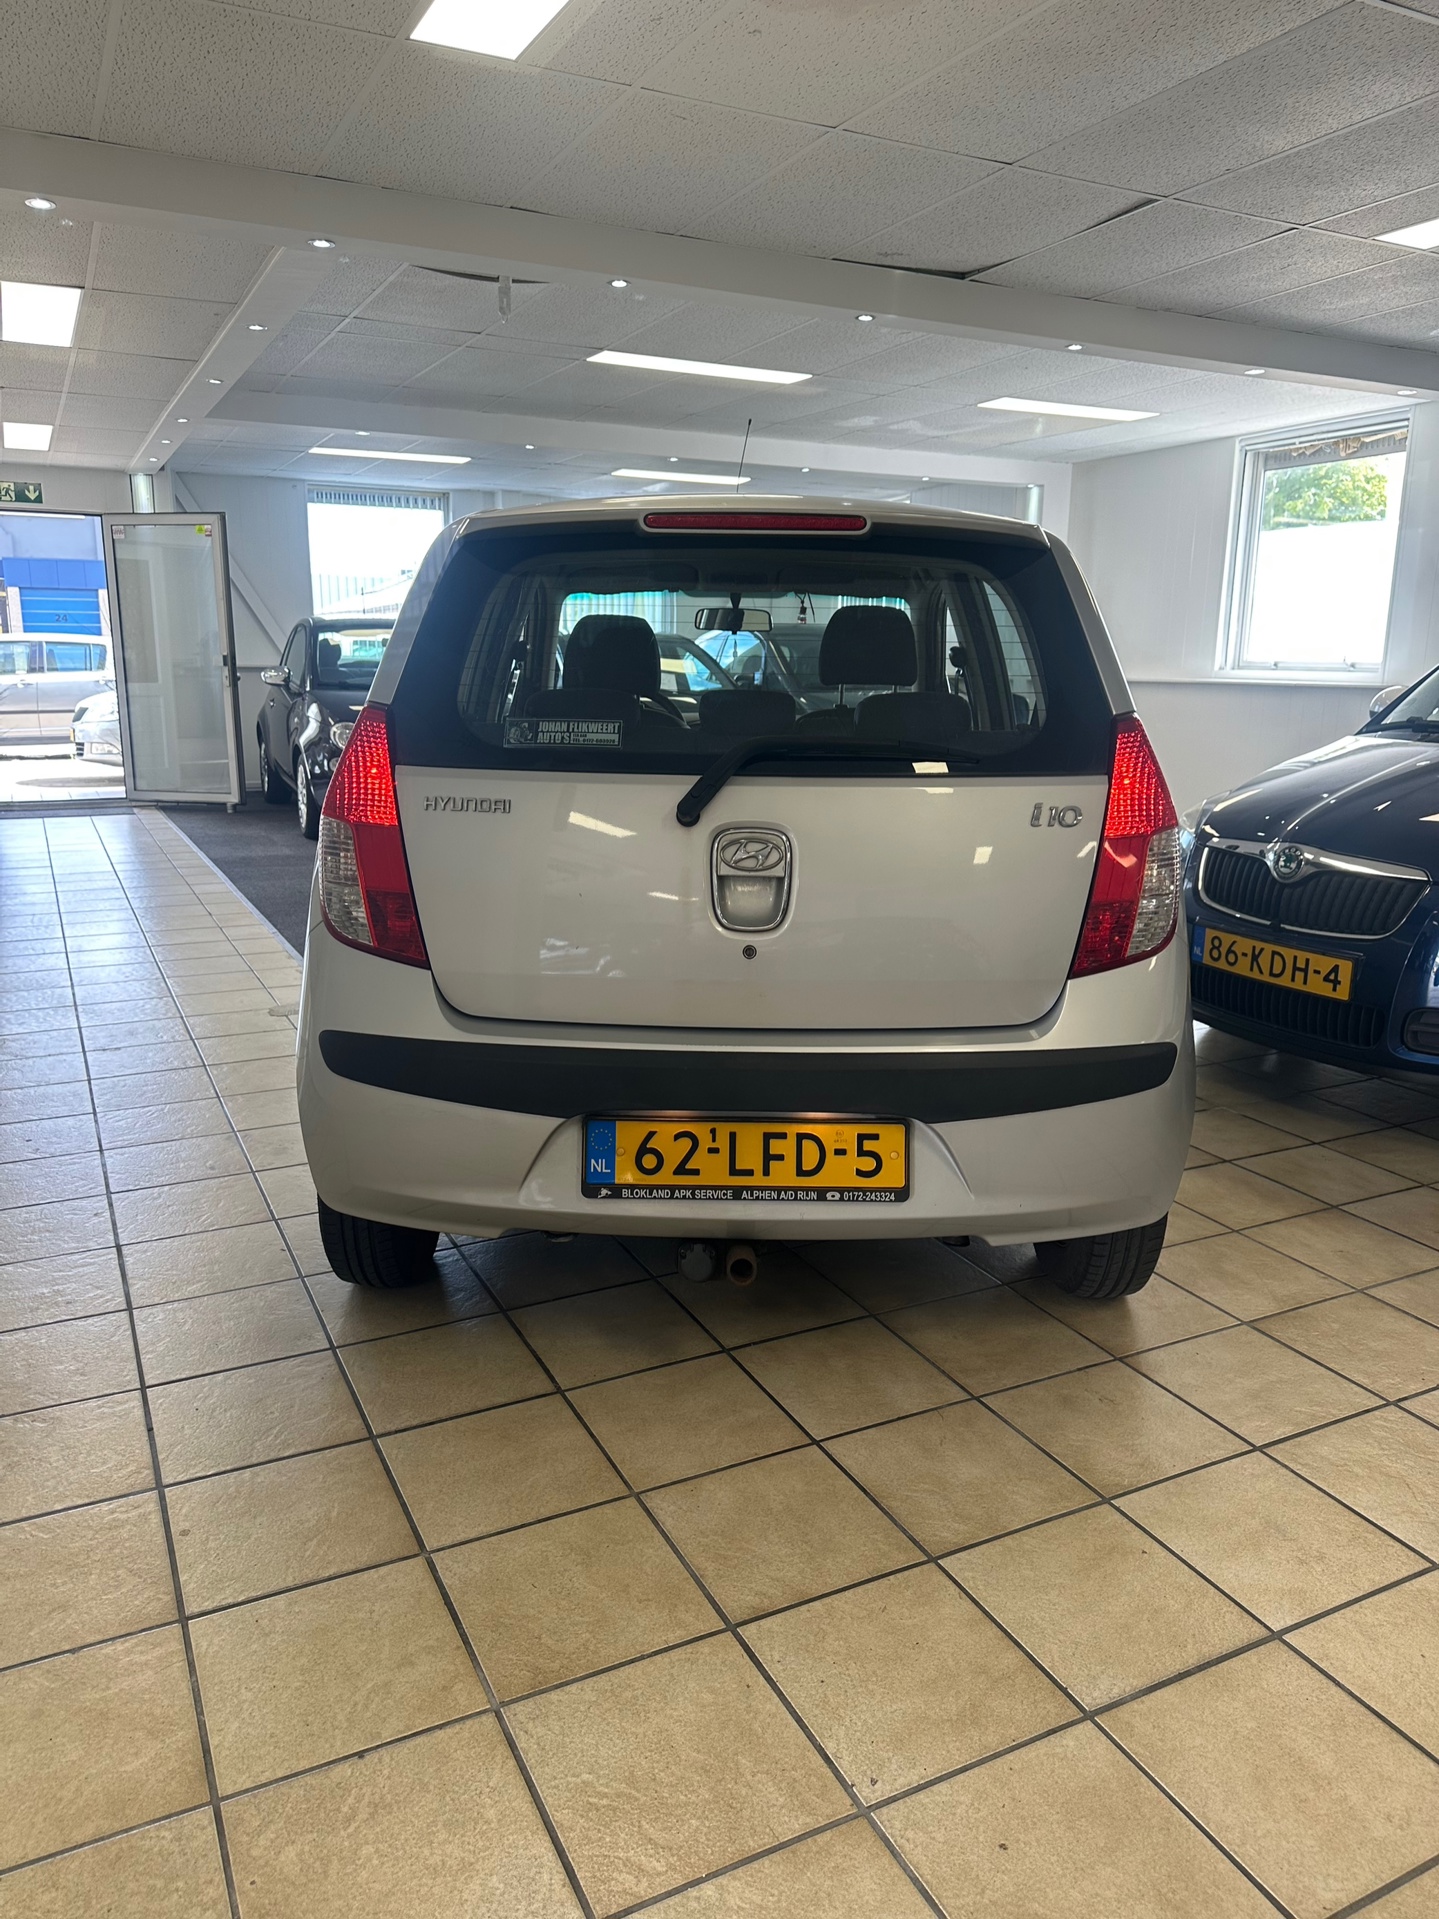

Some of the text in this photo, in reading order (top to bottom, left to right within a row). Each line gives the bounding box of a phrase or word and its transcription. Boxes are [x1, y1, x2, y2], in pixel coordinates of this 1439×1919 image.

[55, 613, 68, 622] 24
[538, 721, 620, 733] JOHAN FLIKWEERT
[537, 732, 570, 744] AUTO'S
[424, 796, 511, 814] HYUNDAI
[1209, 935, 1342, 992] 86-KDH-4
[634, 1130, 883, 1179] 62-LFD-5
[590, 1158, 611, 1173] NL
[621, 1188, 895, 1202] BLOKLAND APK SERVICE ALPHEN A/D RIJN 0172-243324
